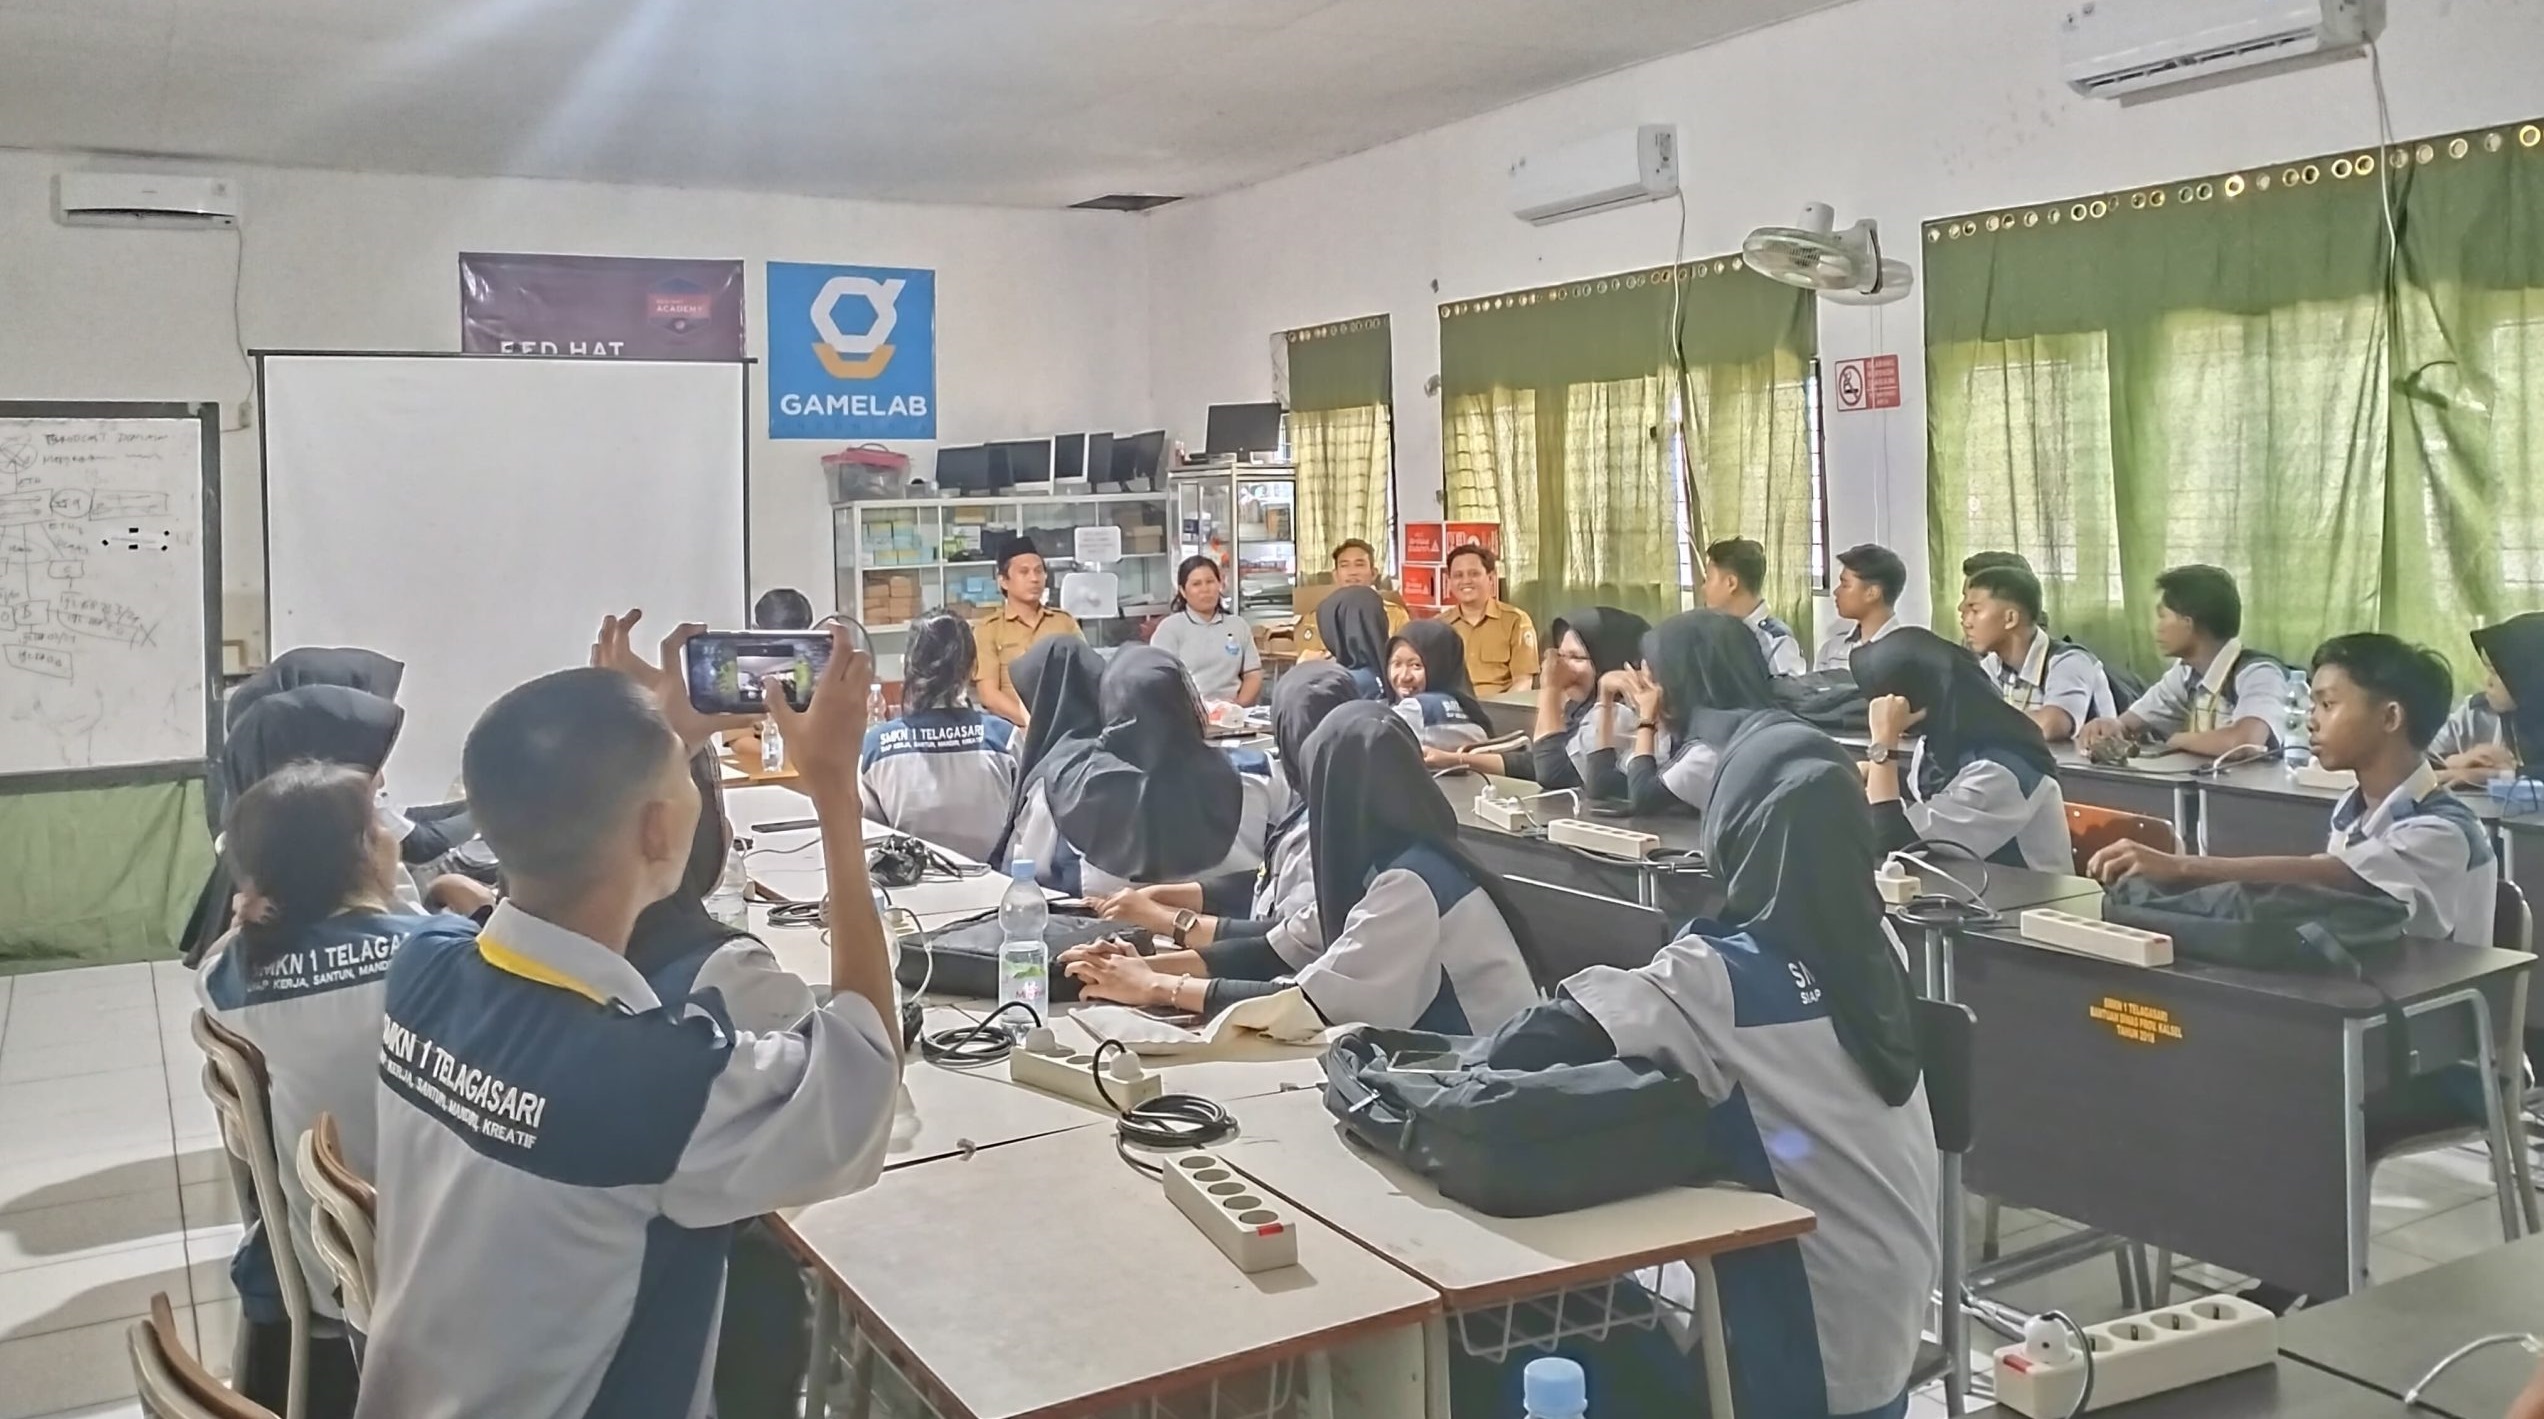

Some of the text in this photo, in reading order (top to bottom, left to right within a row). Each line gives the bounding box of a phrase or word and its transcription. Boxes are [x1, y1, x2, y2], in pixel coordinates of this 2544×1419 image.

[780, 393, 928, 417] GAMELAB
[880, 727, 908, 746] SMKN
[920, 724, 985, 741] TELAGASARI
[309, 949, 318, 972] 1
[325, 932, 410, 968] TELAGA
[273, 977, 309, 990] KERJA,
[313, 969, 356, 986] SANTUN,
[1800, 988, 1821, 1005] SIAP
[420, 1039, 432, 1069] 1
[433, 1047, 546, 1128] TELAGASARI
[482, 1118, 537, 1149] KREATIF
